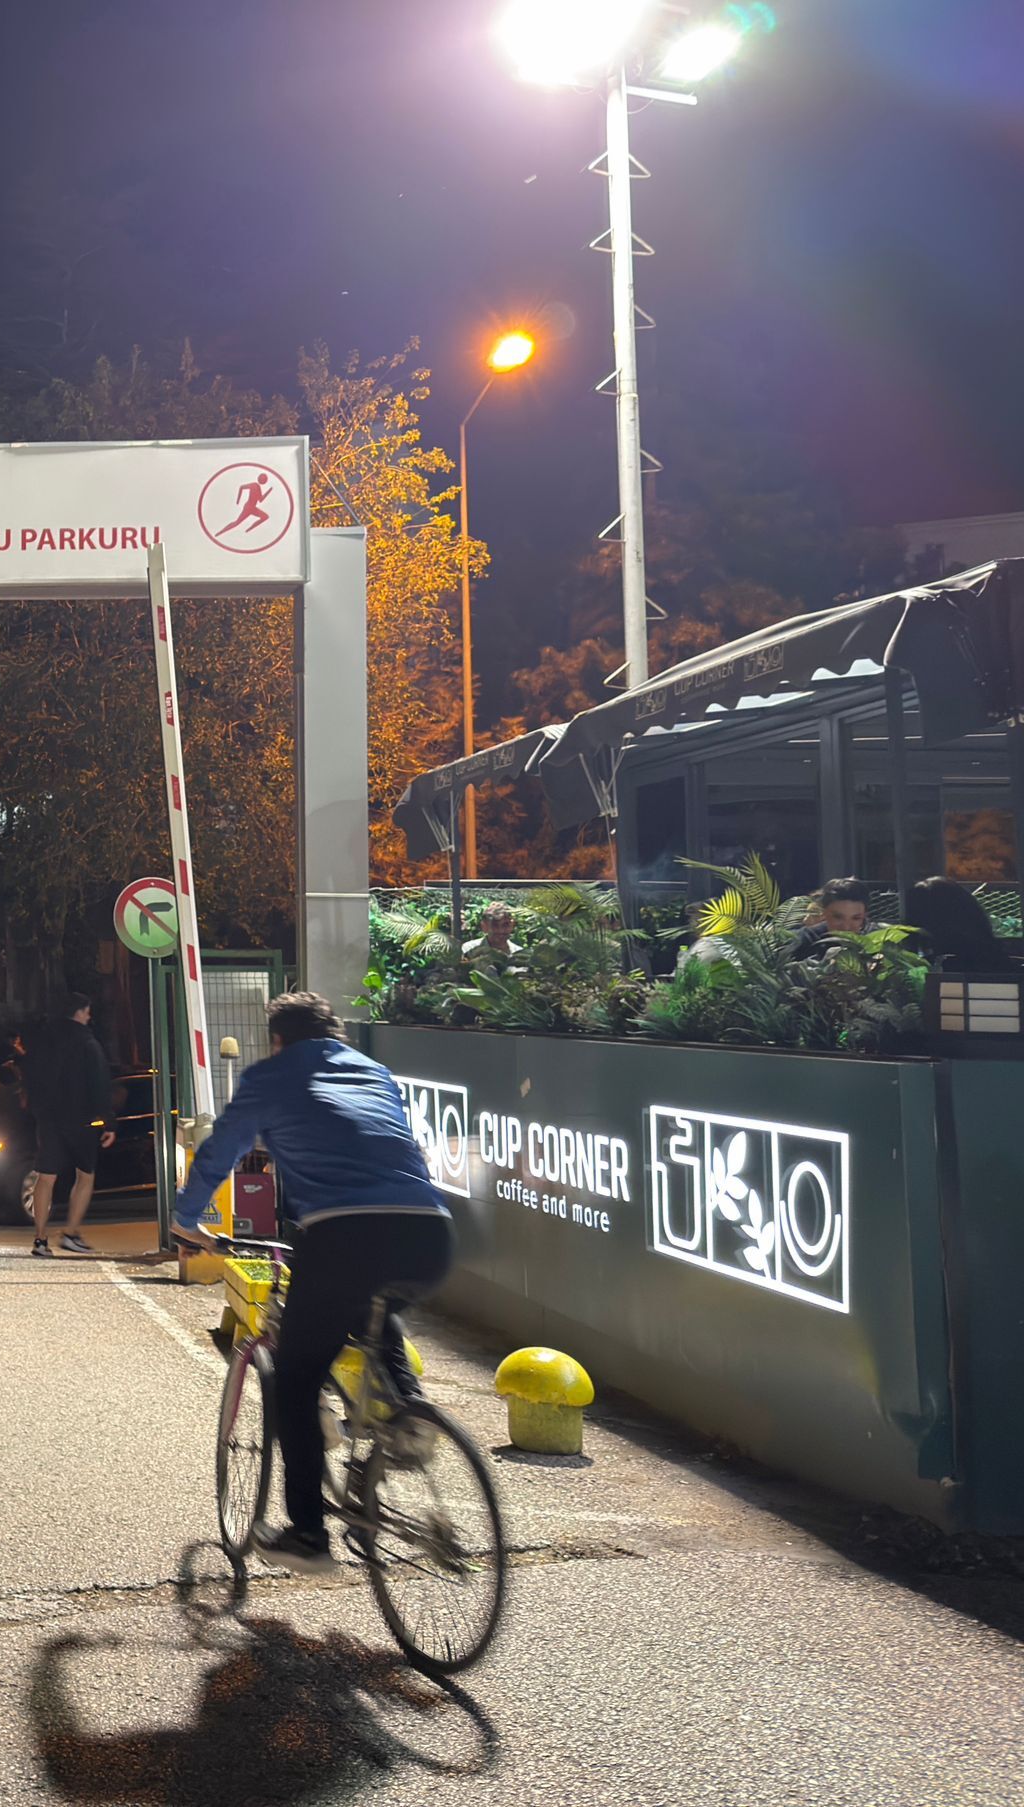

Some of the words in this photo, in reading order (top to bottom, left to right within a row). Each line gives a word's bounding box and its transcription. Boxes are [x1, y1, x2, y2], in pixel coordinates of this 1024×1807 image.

[20, 526, 161, 552] PARKURU
[479, 1111, 522, 1169] CUP
[527, 1122, 631, 1202] CORNER
[496, 1178, 538, 1208] coffee
[542, 1193, 567, 1219] and
[573, 1203, 611, 1233] more
